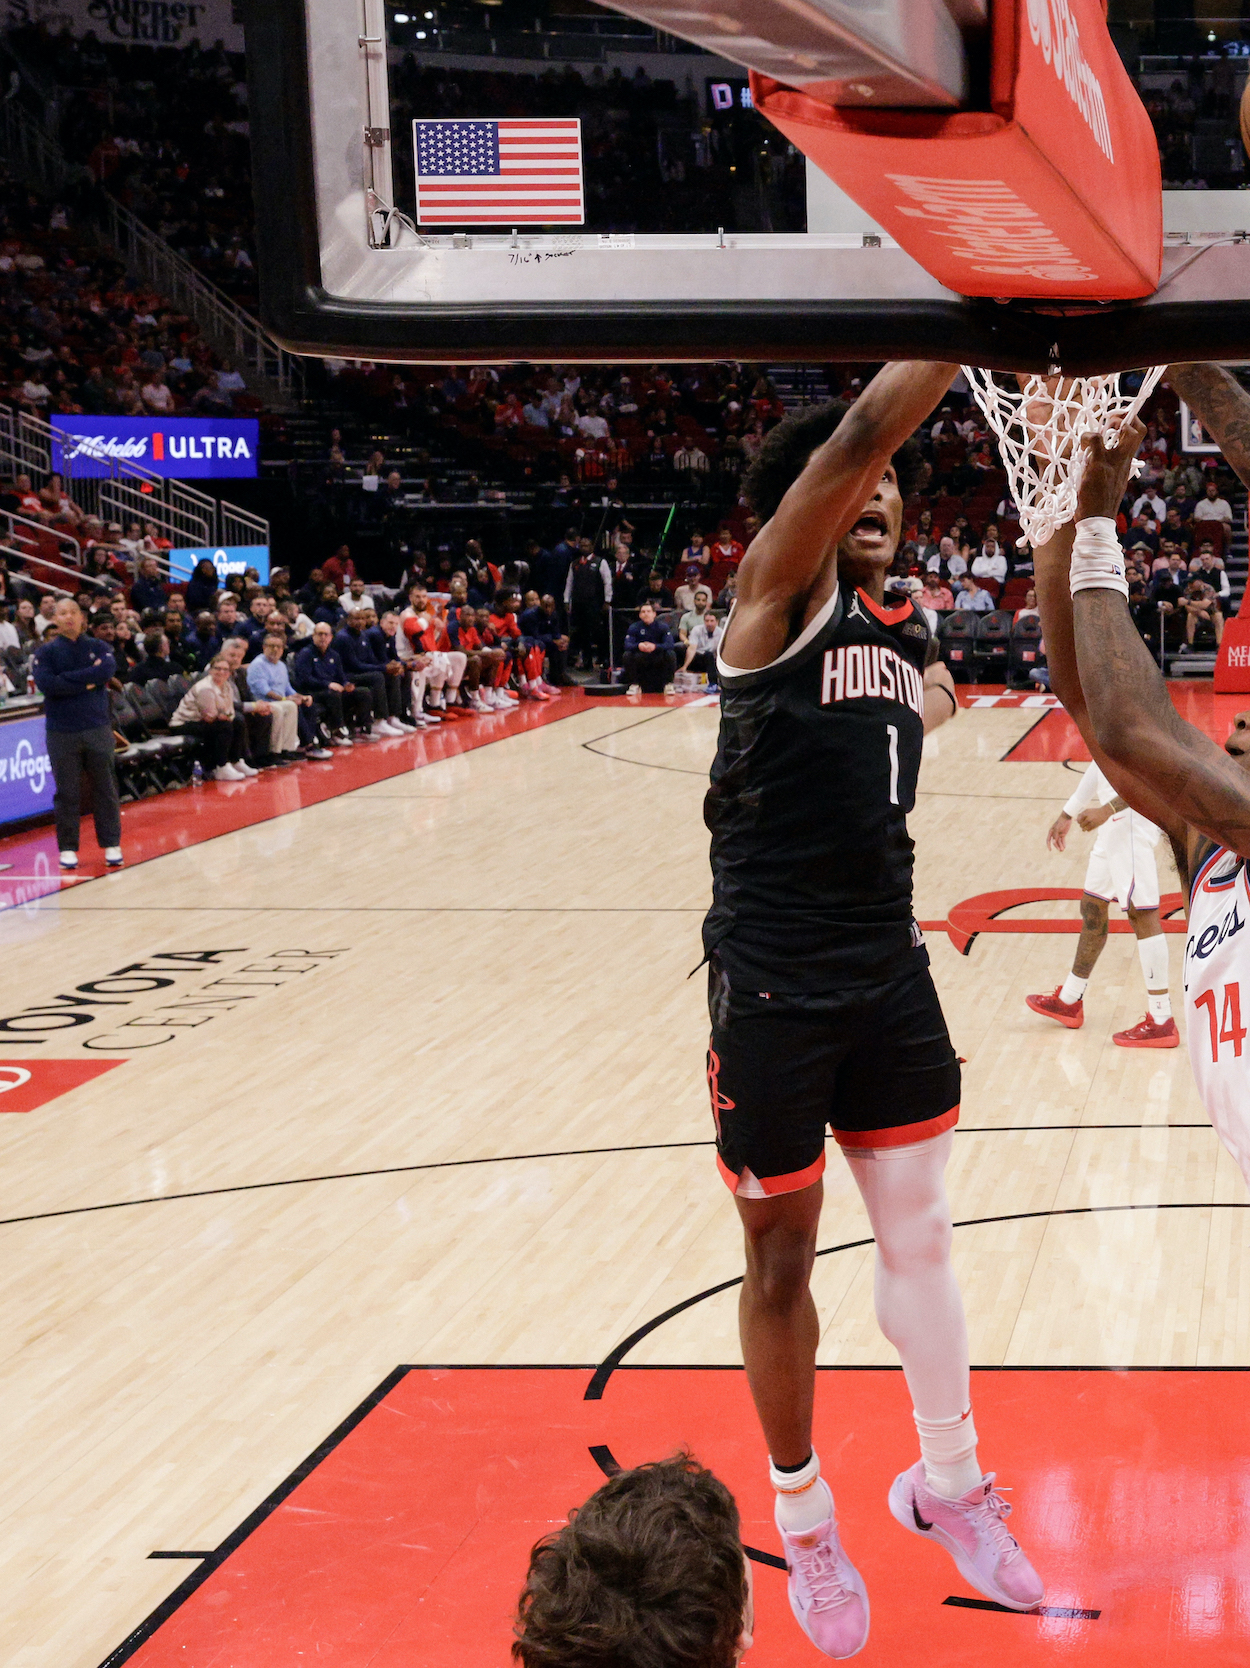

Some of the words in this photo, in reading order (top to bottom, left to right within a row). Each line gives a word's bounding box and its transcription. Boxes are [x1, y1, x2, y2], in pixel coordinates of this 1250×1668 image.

[61, 434, 149, 459] Michelob
[168, 436, 250, 459] ULTRA
[820, 645, 924, 719] HOUSTON
[10, 739, 52, 794] Kroge
[886, 724, 900, 805] 1
[82, 947, 352, 1051] CENTER
[1193, 981, 1247, 1063] 14
